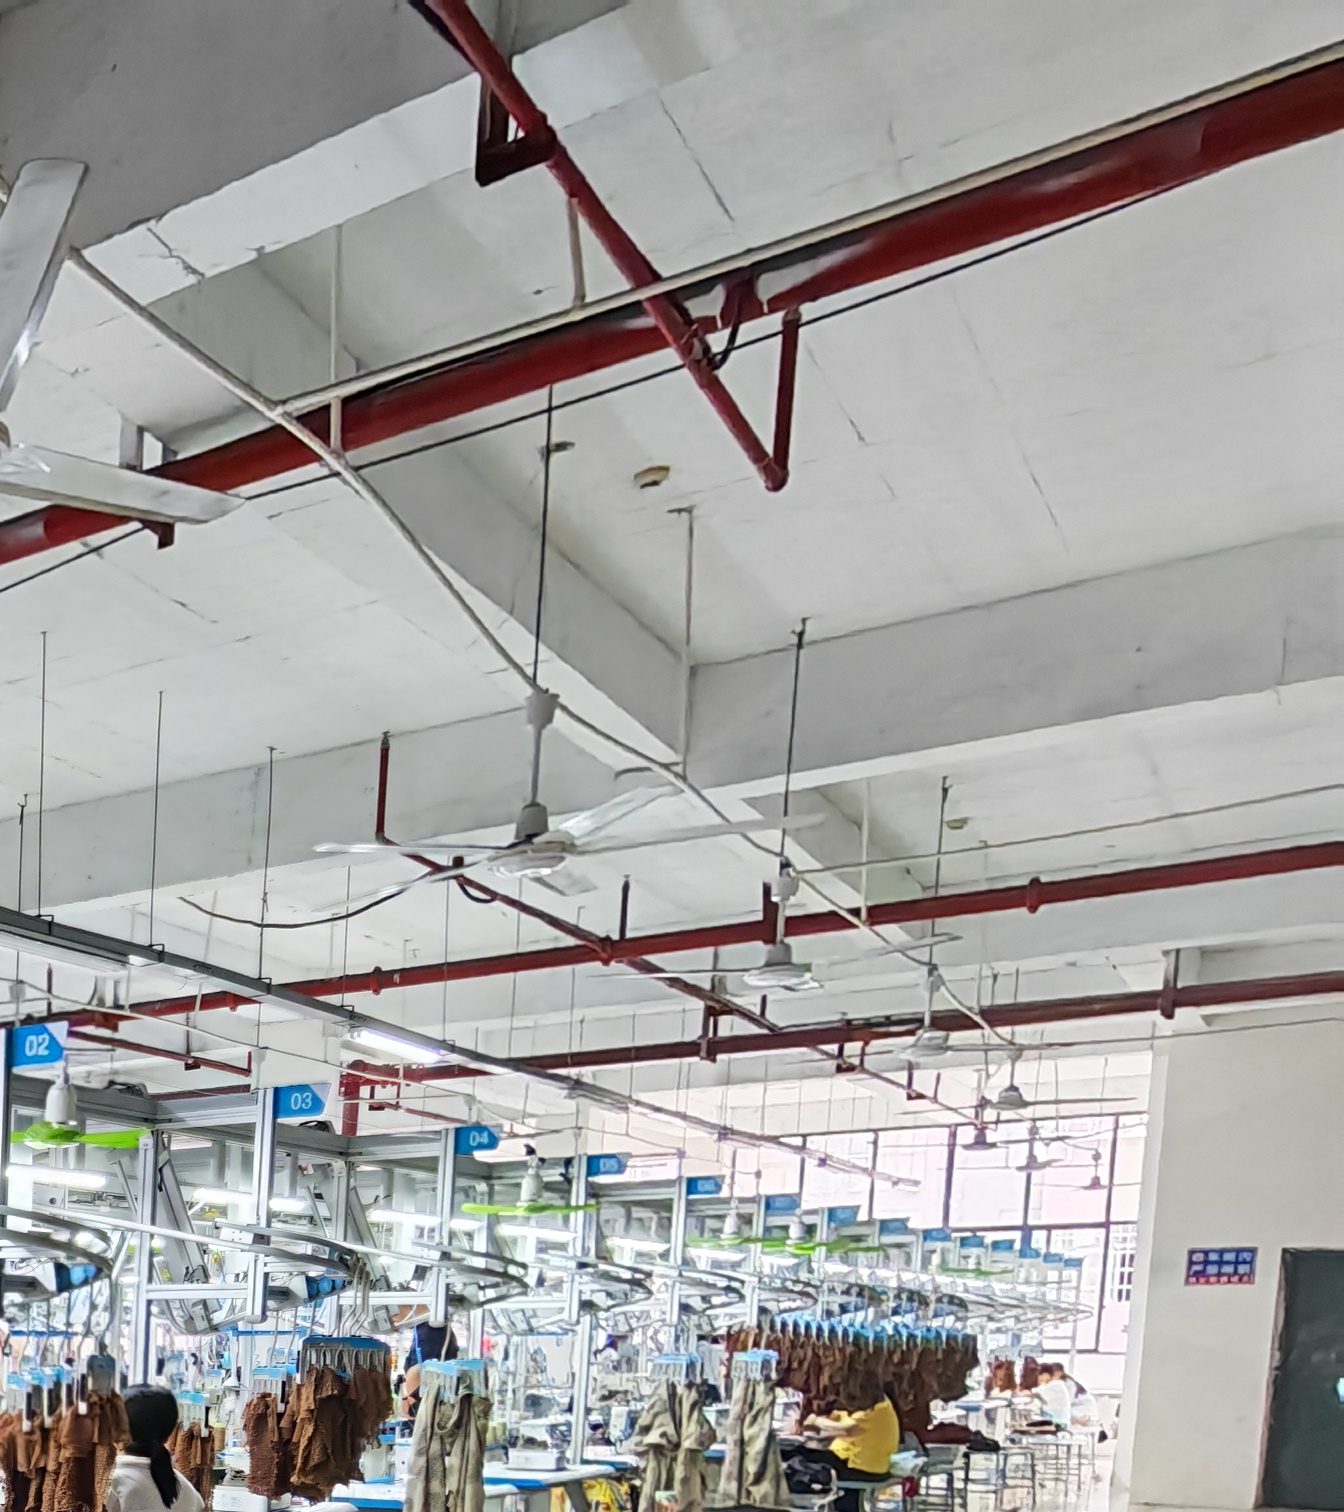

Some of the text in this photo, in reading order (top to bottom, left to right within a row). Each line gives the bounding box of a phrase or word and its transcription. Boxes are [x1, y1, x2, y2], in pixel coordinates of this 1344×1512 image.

[25, 1031, 50, 1057] 02
[290, 1092, 312, 1110] 03
[469, 1130, 489, 1147] 04
